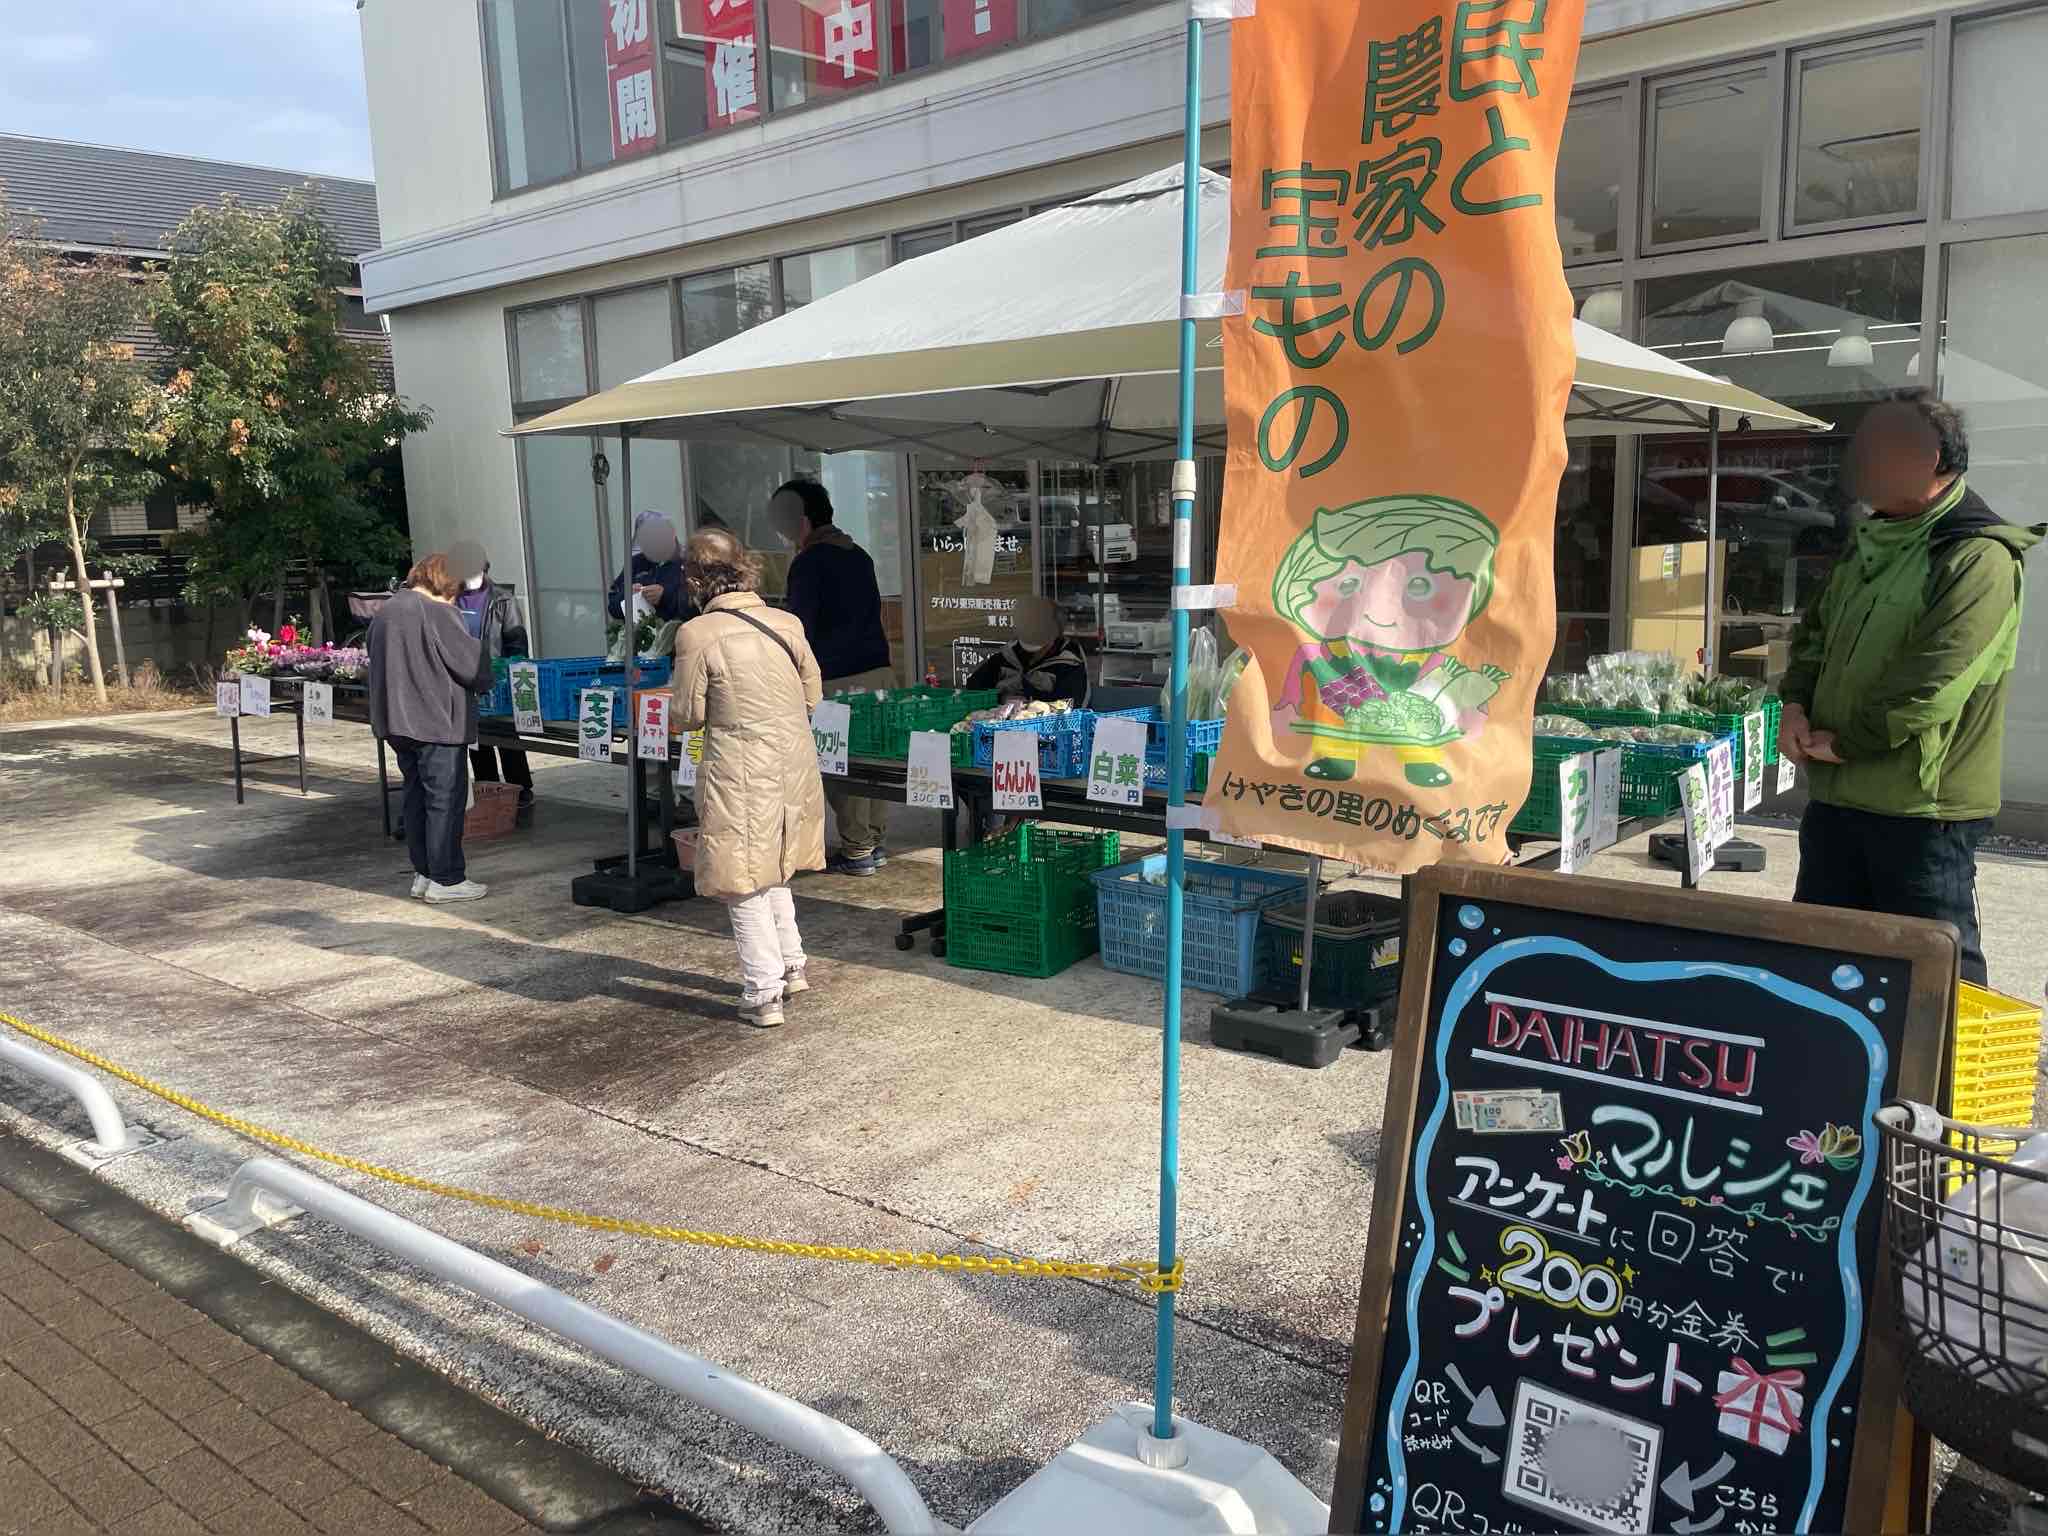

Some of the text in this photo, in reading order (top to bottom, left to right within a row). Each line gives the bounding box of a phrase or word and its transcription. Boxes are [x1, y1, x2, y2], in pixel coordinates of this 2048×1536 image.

[1352, 15, 1447, 356] 農家の
[1252, 162, 1351, 479] 宝もの
[994, 759, 1036, 793] にんじん
[1093, 750, 1140, 786] 白菜
[1487, 1002, 1757, 1097] DAIHATSU
[1591, 1104, 1829, 1211] マルシェ
[1447, 1285, 1704, 1407] プレゼント
[1409, 1409, 1450, 1427] コード
[1414, 1379, 1450, 1405] QR
[1715, 1485, 1779, 1517] こちら
